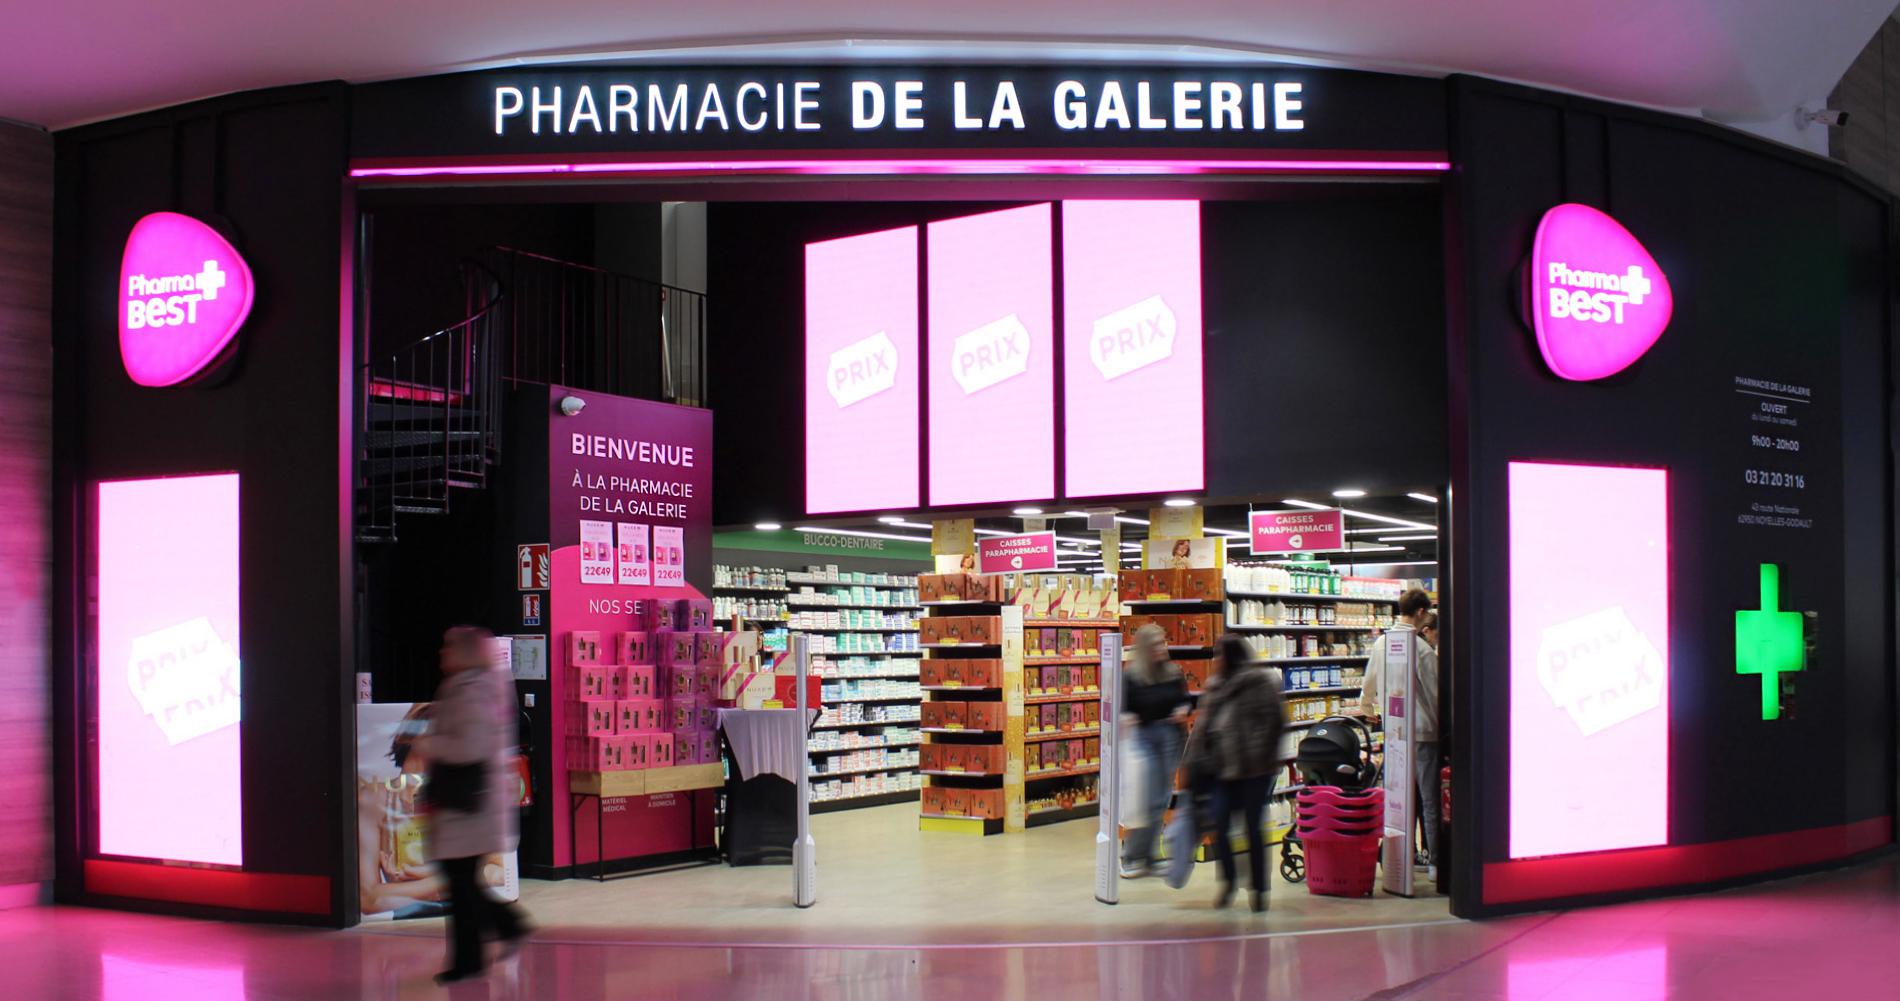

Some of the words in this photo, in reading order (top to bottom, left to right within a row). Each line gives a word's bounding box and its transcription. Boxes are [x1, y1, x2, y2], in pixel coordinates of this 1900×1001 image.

[495, 81, 822, 135] PHARMACIE
[851, 80, 924, 130] DE
[952, 80, 1026, 130] LA
[1052, 79, 1305, 131] GALERIE
[128, 273, 195, 297] Pharma
[1548, 261, 1620, 292] Pharma
[1097, 313, 1167, 362] PRIX
[957, 331, 1023, 376] PRIX
[833, 348, 891, 393] PRIX
[1787, 384, 1811, 397] GALERIE
[1760, 402, 1788, 415] OUVERT
[572, 432, 693, 468] BIENVENUE
[1751, 435, 1771, 448] 9h00
[1776, 438, 1800, 451] 20h00
[572, 468, 583, 488] À
[587, 473, 606, 490] LA
[610, 475, 693, 498] PHARMACIE
[1745, 469, 1758, 484] 03
[1759, 470, 1769, 485] 21
[1770, 471, 1783, 487] 20
[1784, 473, 1793, 488] 31
[1795, 474, 1805, 489] 16
[580, 495, 601, 512] DE
[605, 498, 624, 515] LA
[628, 500, 687, 519] GALERIE
[1276, 515, 1314, 524] CAISSES
[1258, 524, 1334, 535] PARAPHARMACIE
[803, 533, 884, 551] BUCCO-DENTAIRE
[999, 538, 1032, 547] CAISSES
[985, 546, 1048, 558] PARAPHARMACIE
[584, 566, 611, 576] 22€49
[622, 567, 648, 578] 22€49
[657, 570, 682, 579] 22€49
[589, 599, 620, 615] NOS
[624, 600, 643, 615] SE
